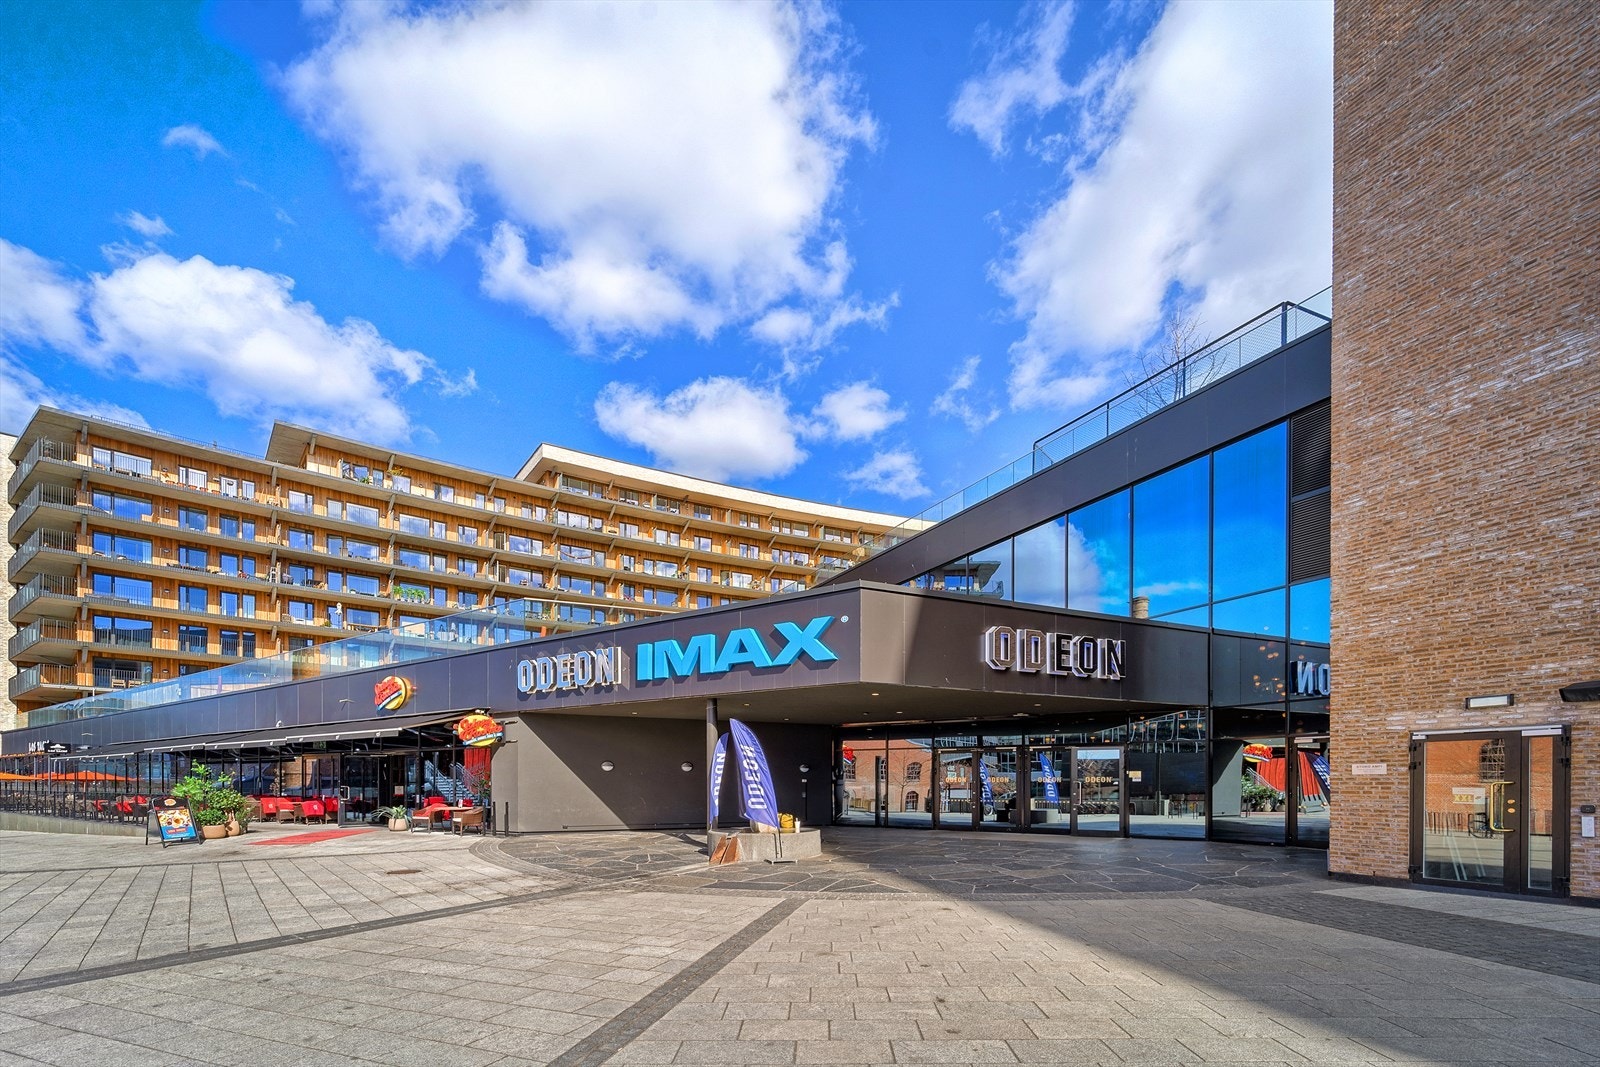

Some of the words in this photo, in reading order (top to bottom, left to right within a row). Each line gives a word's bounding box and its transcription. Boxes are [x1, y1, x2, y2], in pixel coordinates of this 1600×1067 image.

[517, 647, 622, 694] ODEON
[637, 615, 838, 681] IMAX
[985, 626, 1126, 680] ODEON
[740, 744, 767, 809] ODEON
